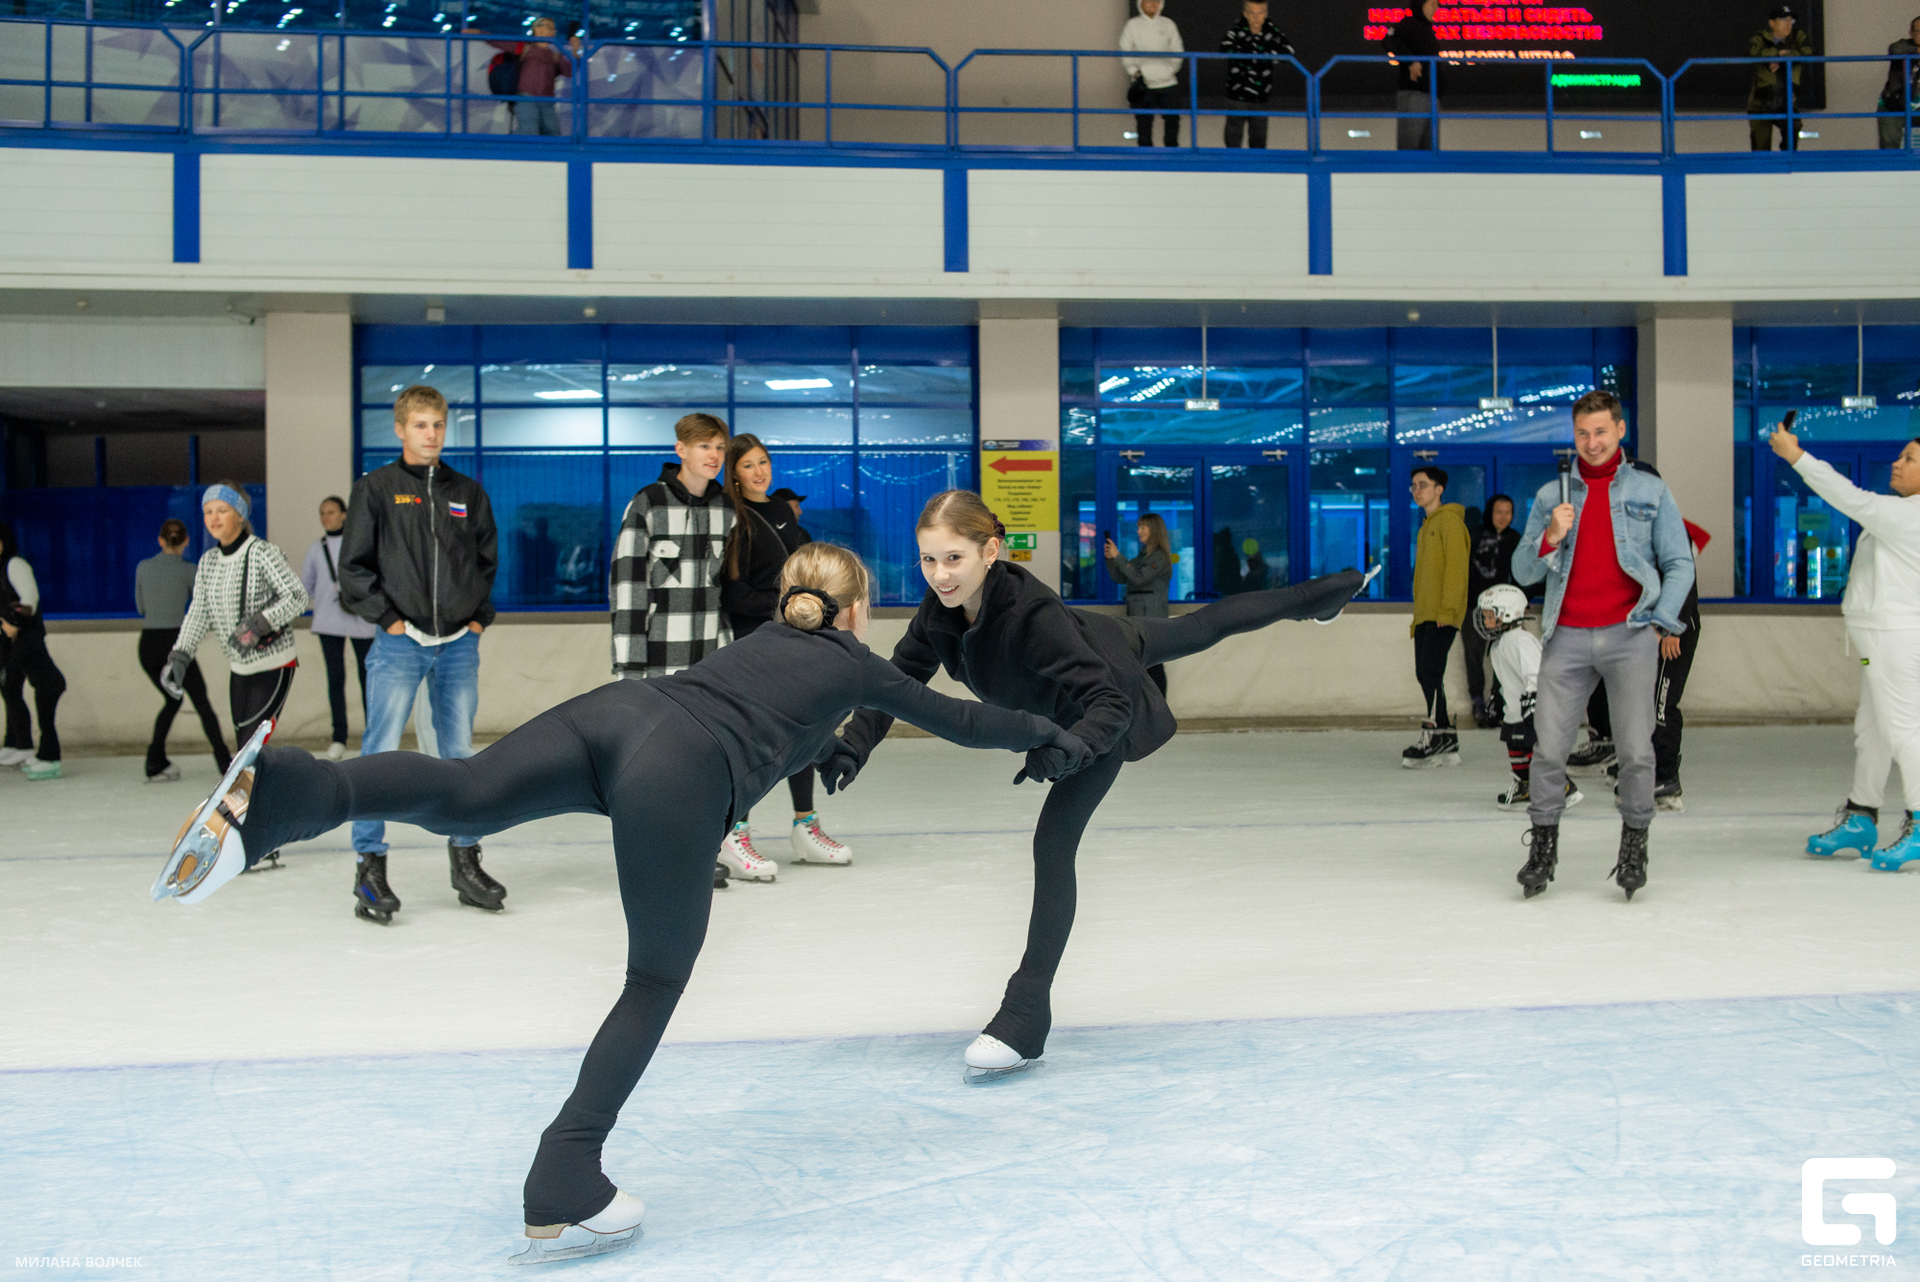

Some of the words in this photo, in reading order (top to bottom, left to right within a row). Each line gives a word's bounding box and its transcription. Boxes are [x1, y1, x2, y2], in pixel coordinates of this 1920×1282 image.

[1368, 8, 1505, 22] НАВВАТЬСЯ
[1507, 8, 1522, 22] И
[1524, 8, 1593, 24] СИДЕТЬ
[1462, 25, 1603, 40] БЕЗОПАСНОСТИ!
[1551, 74, 1641, 88] АДМИНИСТРАЦИЯ
